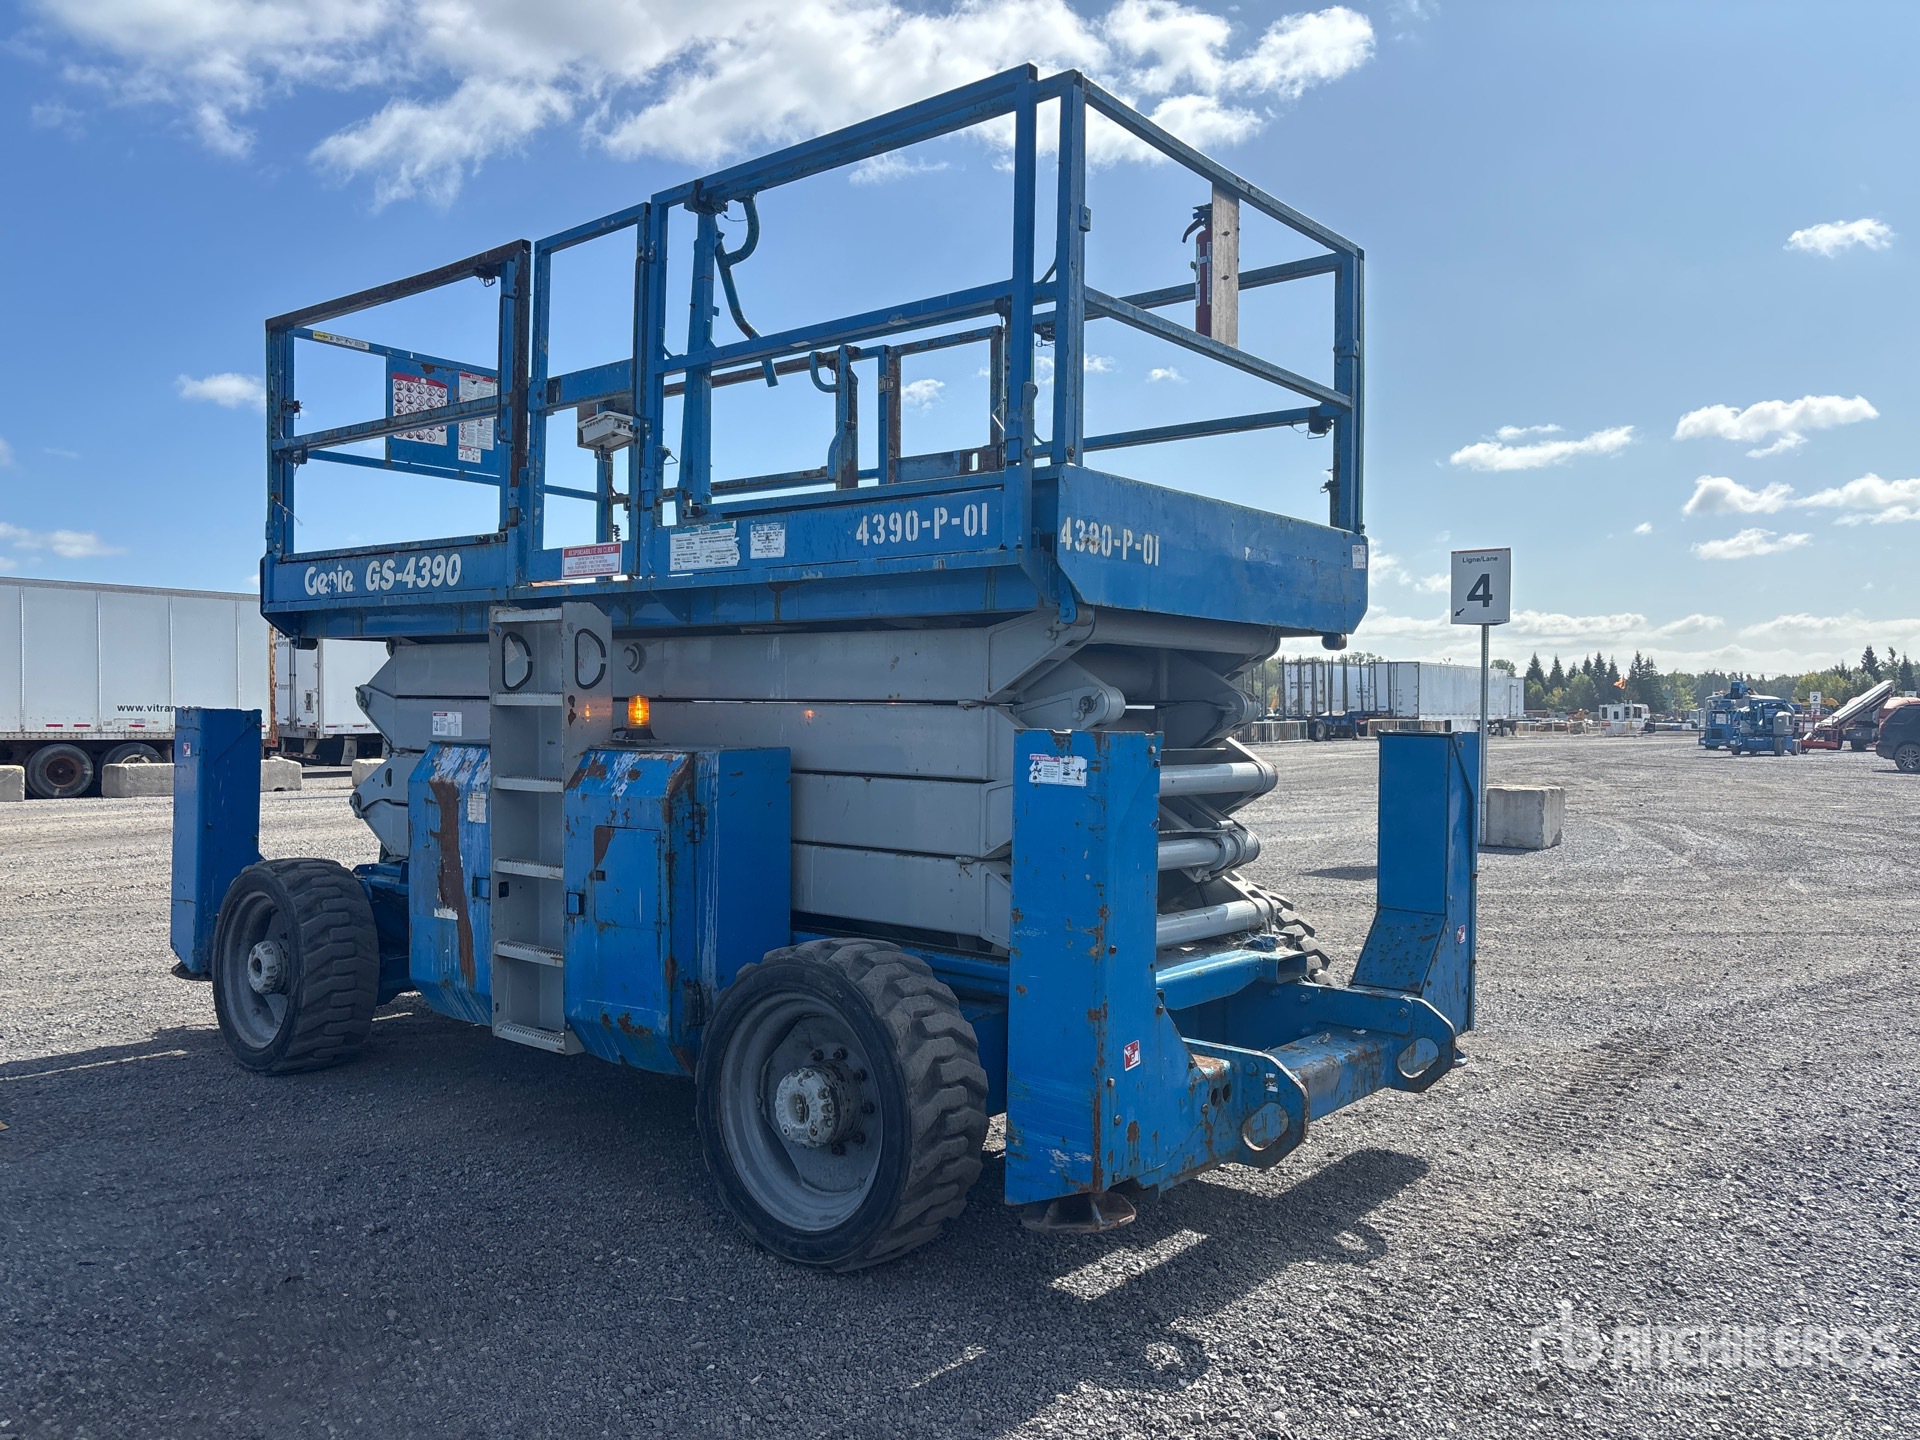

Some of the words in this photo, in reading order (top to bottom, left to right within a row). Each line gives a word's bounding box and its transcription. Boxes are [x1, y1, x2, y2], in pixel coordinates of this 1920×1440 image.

[603, 545, 616, 553] CLIENT
[1462, 556, 1498, 564] Ligne/Lane
[304, 564, 354, 596] Genie
[365, 553, 462, 592] GS-4390
[1466, 573, 1493, 608] 4
